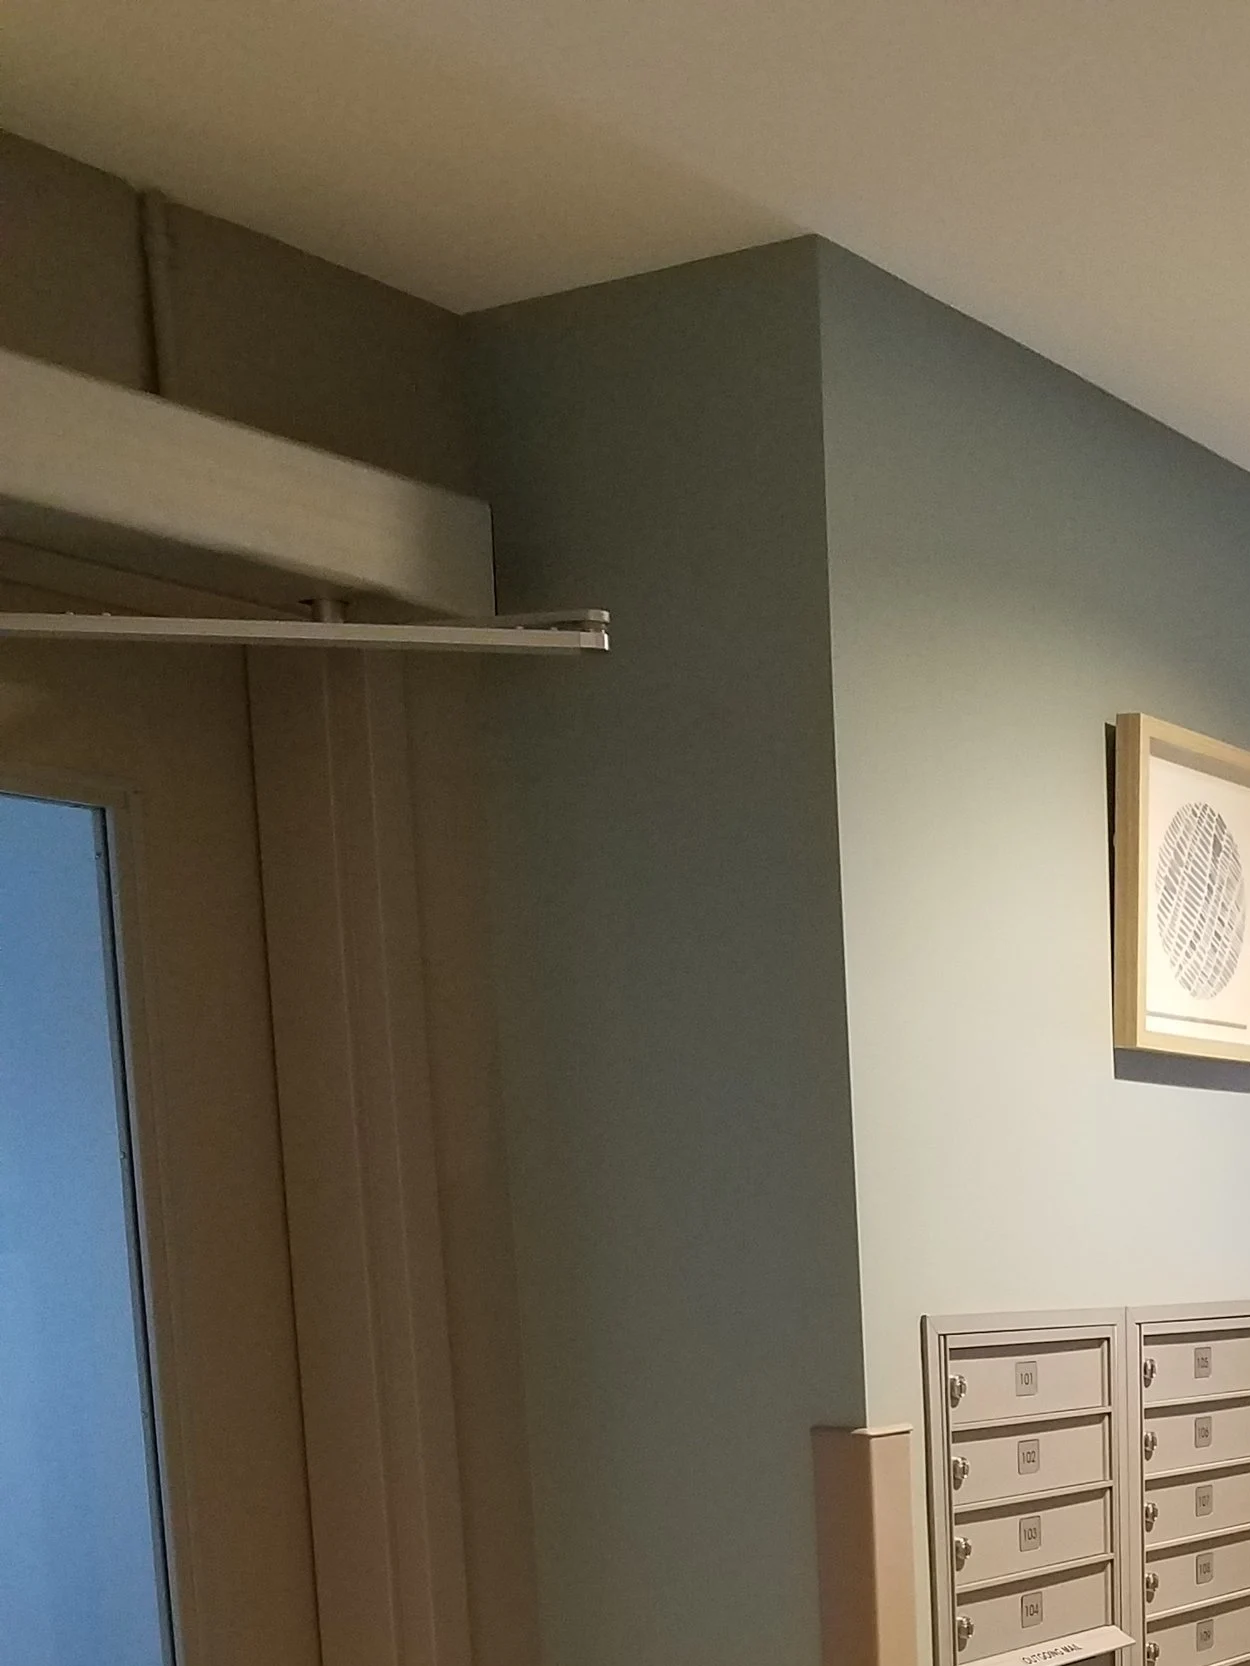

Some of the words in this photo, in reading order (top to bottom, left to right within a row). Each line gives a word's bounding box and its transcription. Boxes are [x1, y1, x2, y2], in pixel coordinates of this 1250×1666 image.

[1020, 1372, 1033, 1385] 101
[1022, 1450, 1036, 1464] 102
[1023, 1527, 1037, 1541] 103
[1025, 1603, 1039, 1617] 104
[1022, 1648, 1064, 1665] OUTGOING
[1060, 1643, 1083, 1654] MAIL
